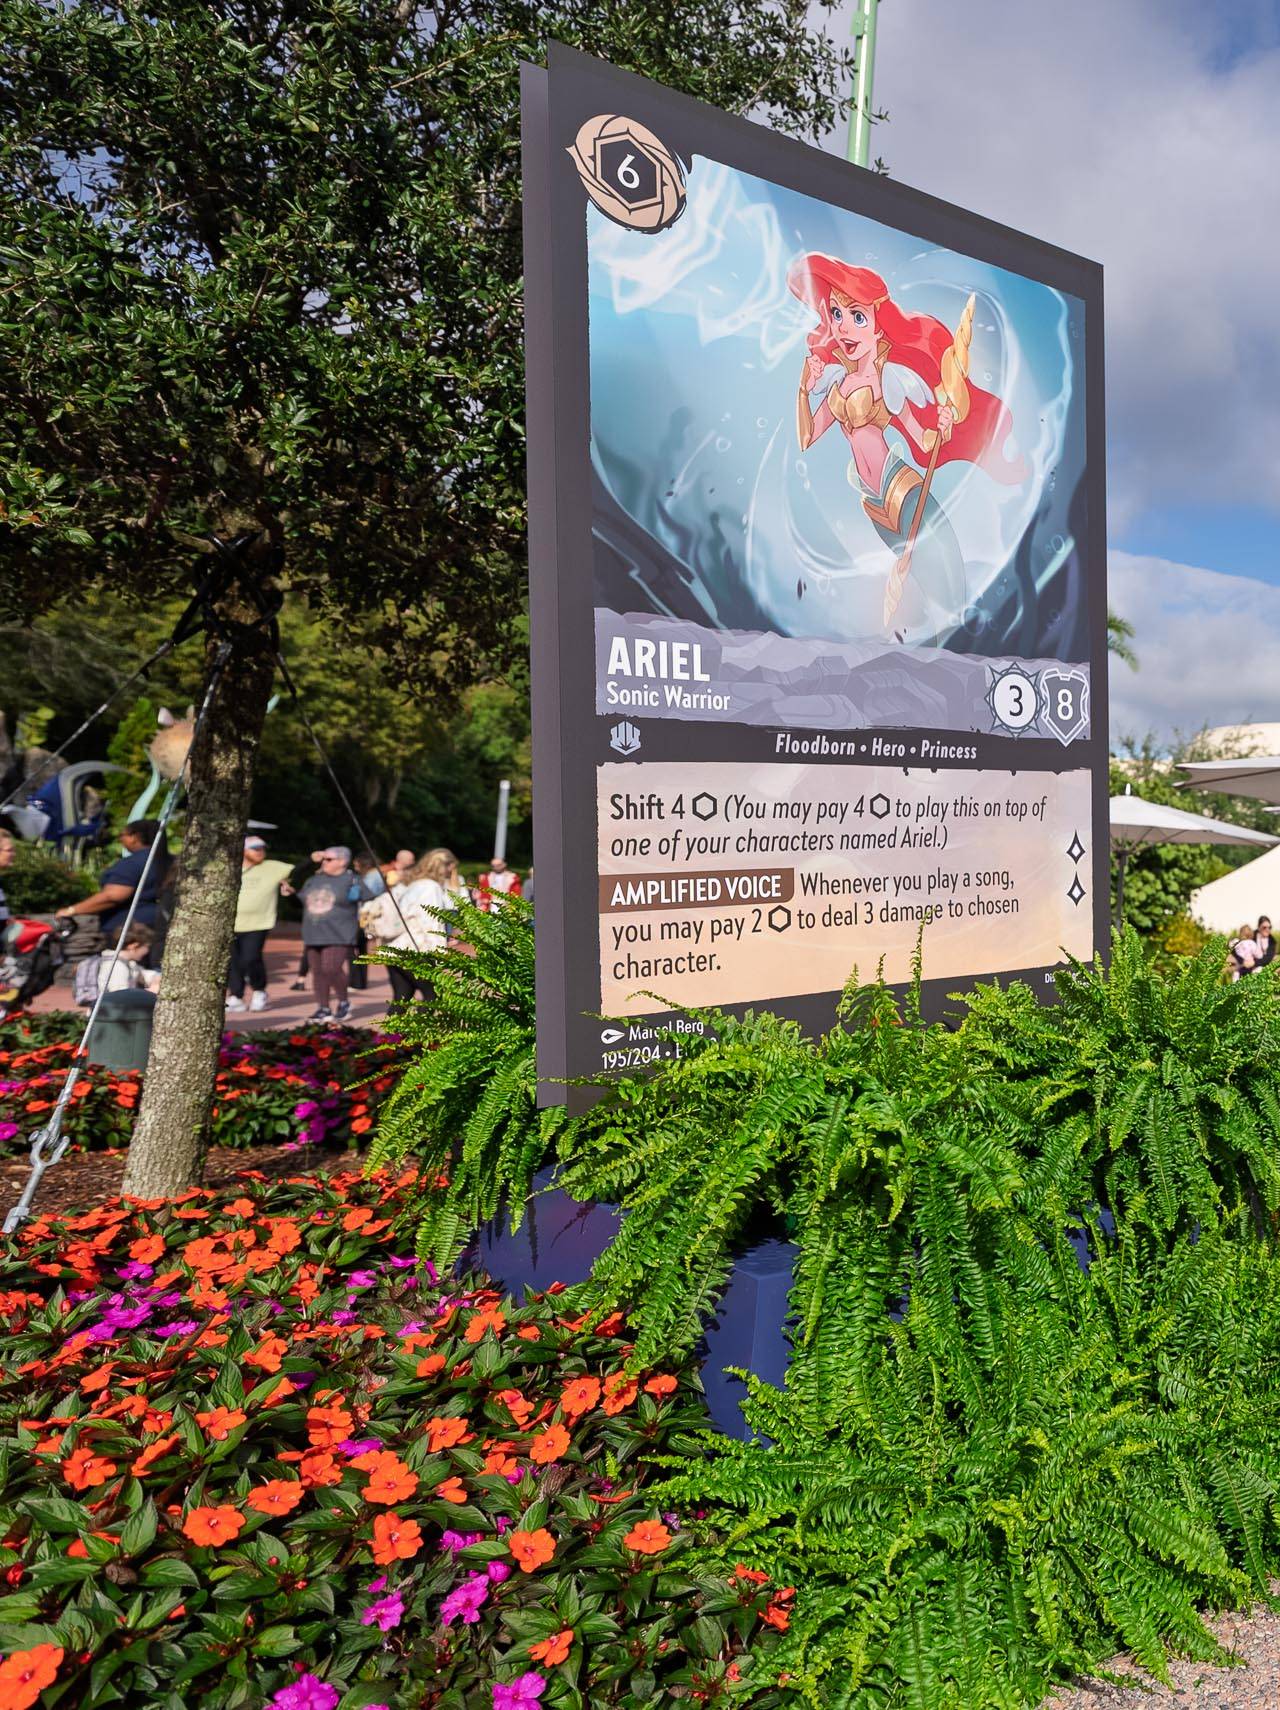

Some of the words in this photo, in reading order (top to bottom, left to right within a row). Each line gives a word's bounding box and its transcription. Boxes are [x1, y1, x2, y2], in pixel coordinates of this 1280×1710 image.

[617, 154, 640, 189] 6
[607, 636, 711, 682] ARIEL
[606, 681, 660, 707] Sonic
[664, 685, 731, 711] Warrior
[1008, 685, 1024, 717] 3
[1057, 688, 1074, 721] 8
[775, 733, 856, 756] Floodborn
[871, 738, 906, 758] Hero
[921, 740, 977, 760] Princess
[610, 793, 665, 820] Shift
[671, 794, 686, 820] 4
[724, 794, 766, 823] (You
[772, 802, 812, 825] may
[816, 802, 849, 825] pay
[853, 795, 865, 818] 4
[896, 797, 911, 818] to
[916, 795, 949, 823] play
[953, 796, 979, 817] this
[984, 800, 1001, 817] on
[1006, 799, 1028, 822] top
[1032, 796, 1048, 822] of
[611, 837, 651, 857] one
[658, 829, 683, 862] of
[685, 835, 730, 861] your
[735, 828, 835, 853] characters
[840, 826, 897, 850] named
[900, 825, 948, 850] Ariel.)
[610, 877, 722, 907] AMPLIFIED
[724, 875, 782, 900] VOICE
[800, 872, 889, 897] Whenever
[893, 875, 922, 897] you
[927, 867, 959, 894] play
[962, 873, 971, 888] a
[975, 870, 1015, 890] song,
[612, 923, 651, 951] you
[660, 920, 704, 944] may
[710, 917, 745, 942] pay
[751, 908, 763, 934] 2
[797, 909, 816, 929] to
[822, 902, 858, 927] deal
[864, 901, 874, 924] 3
[879, 900, 943, 925] damage
[947, 899, 964, 918] to
[968, 895, 1020, 916] chosen
[613, 951, 722, 980] character.
[676, 1019, 705, 1036] Berg
[601, 1044, 661, 1070] 195/204
